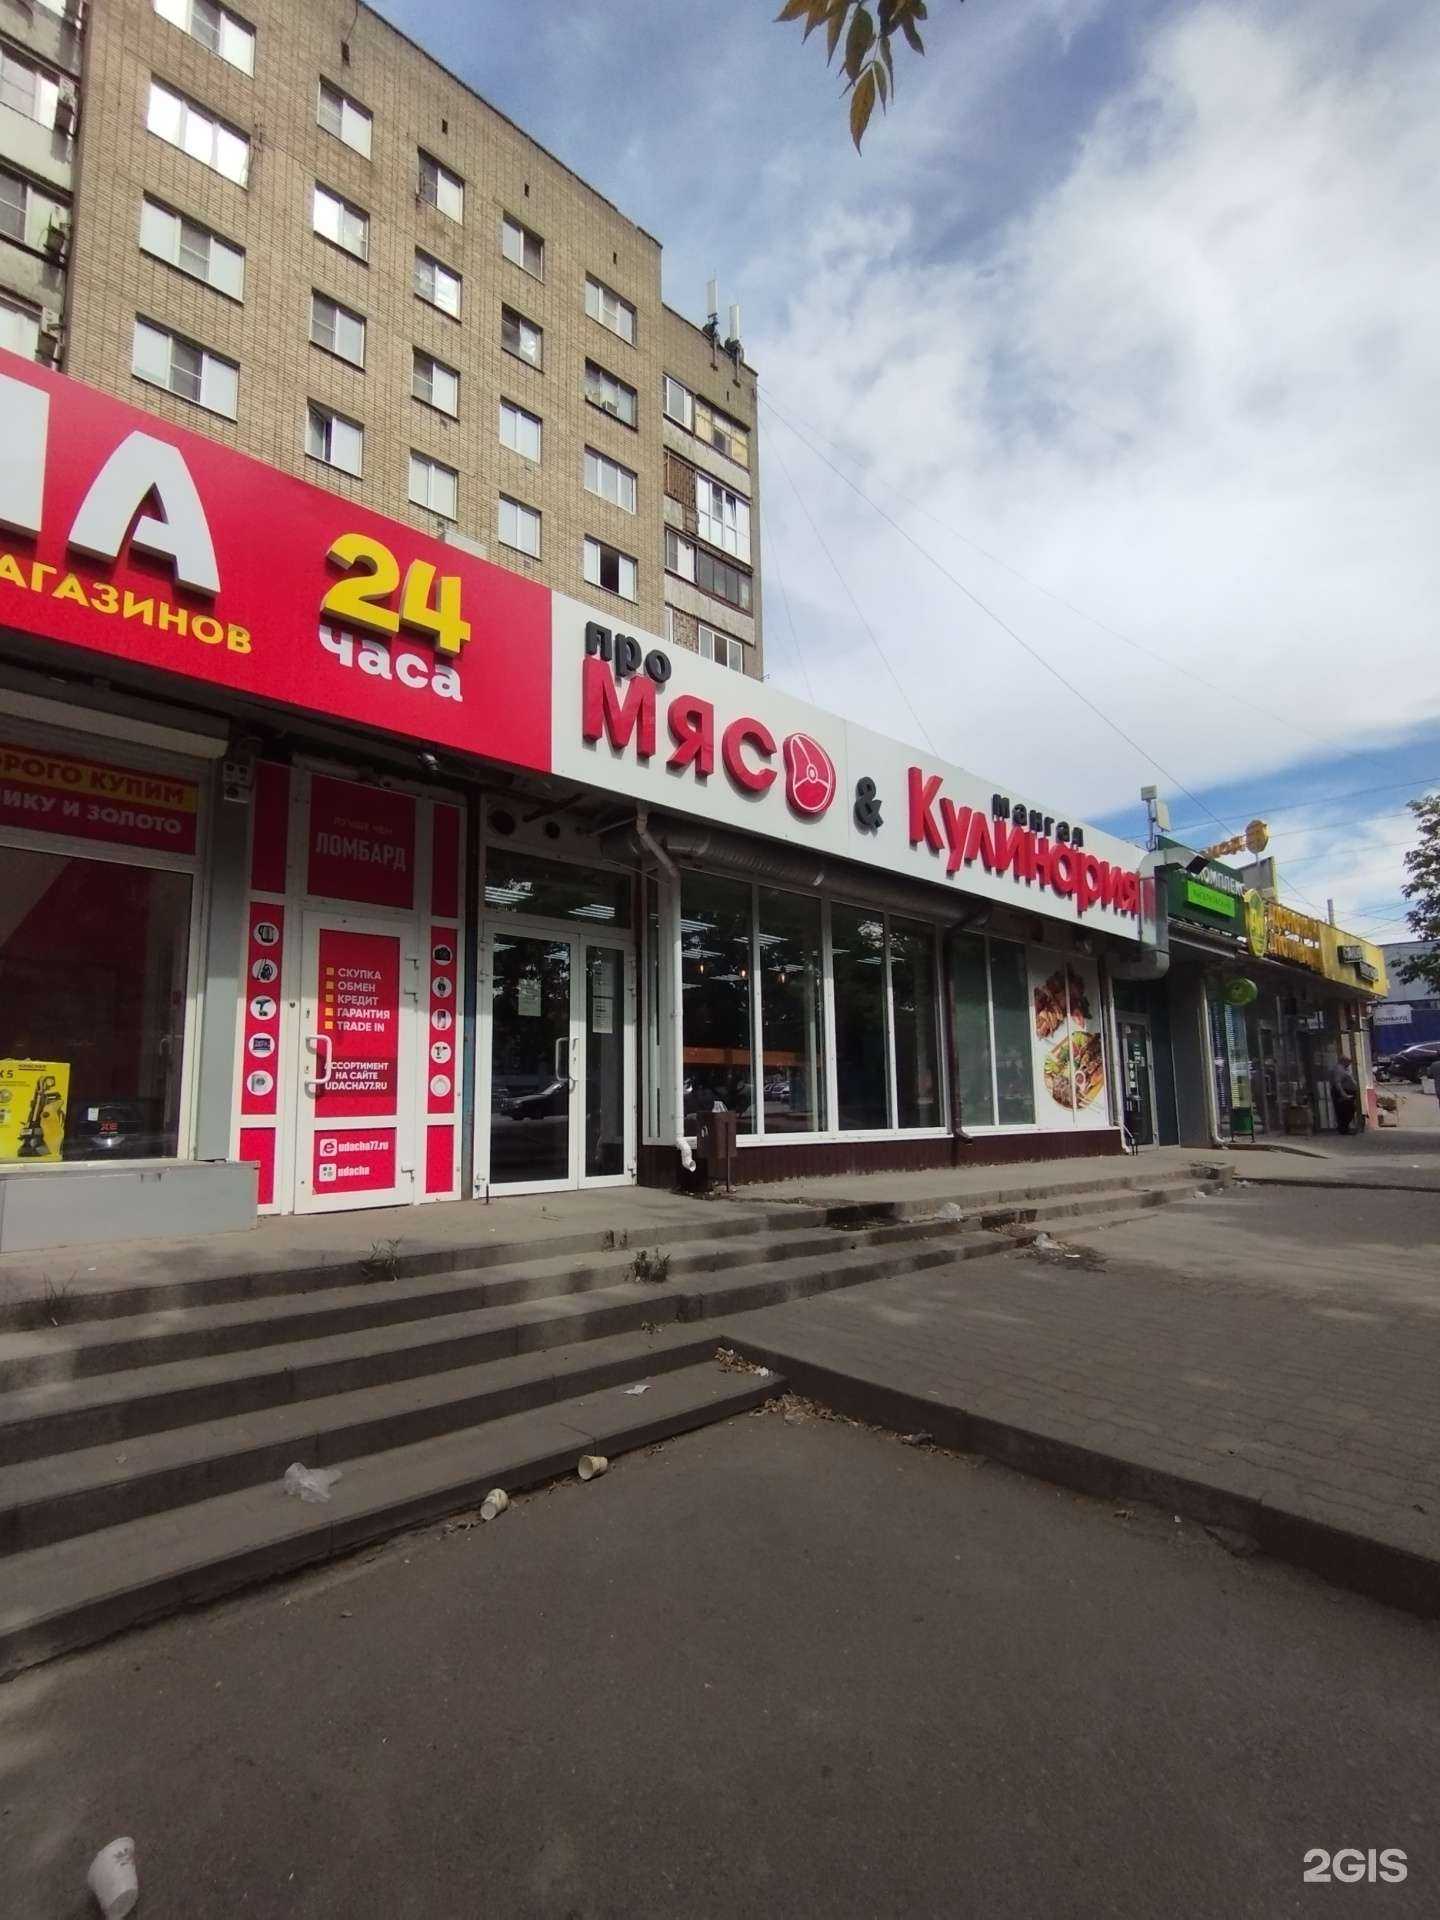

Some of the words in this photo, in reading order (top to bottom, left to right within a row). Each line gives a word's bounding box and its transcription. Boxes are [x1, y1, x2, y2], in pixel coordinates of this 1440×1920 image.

[321, 532, 471, 656] 24
[0, 553, 253, 654] АГАЗИНОВ
[585, 620, 673, 684] про
[318, 625, 464, 703] часа
[0, 753, 83, 784] РОГО
[89, 770, 185, 805] КУПИМ
[0, 788, 57, 812] ИКУ
[87, 804, 183, 835] ЗОЛОТО
[315, 831, 407, 873] ЛОМБАРД
[337, 967, 382, 980] СКУПКА
[337, 980, 376, 993] ОБМЕН
[337, 994, 379, 1006] КРЕДИТ
[337, 1007, 391, 1020] ГАРАНТИЯ
[336, 1020, 372, 1032] TRADE
[374, 1022, 385, 1033] IN
[335, 1071, 348, 1080] НА
[349, 1070, 378, 1080] САЙТЕ
[324, 1081, 388, 1091] UDACHA77.RU
[338, 1140, 389, 1152] udacha77.ru
[337, 1165, 370, 1177] udacha
